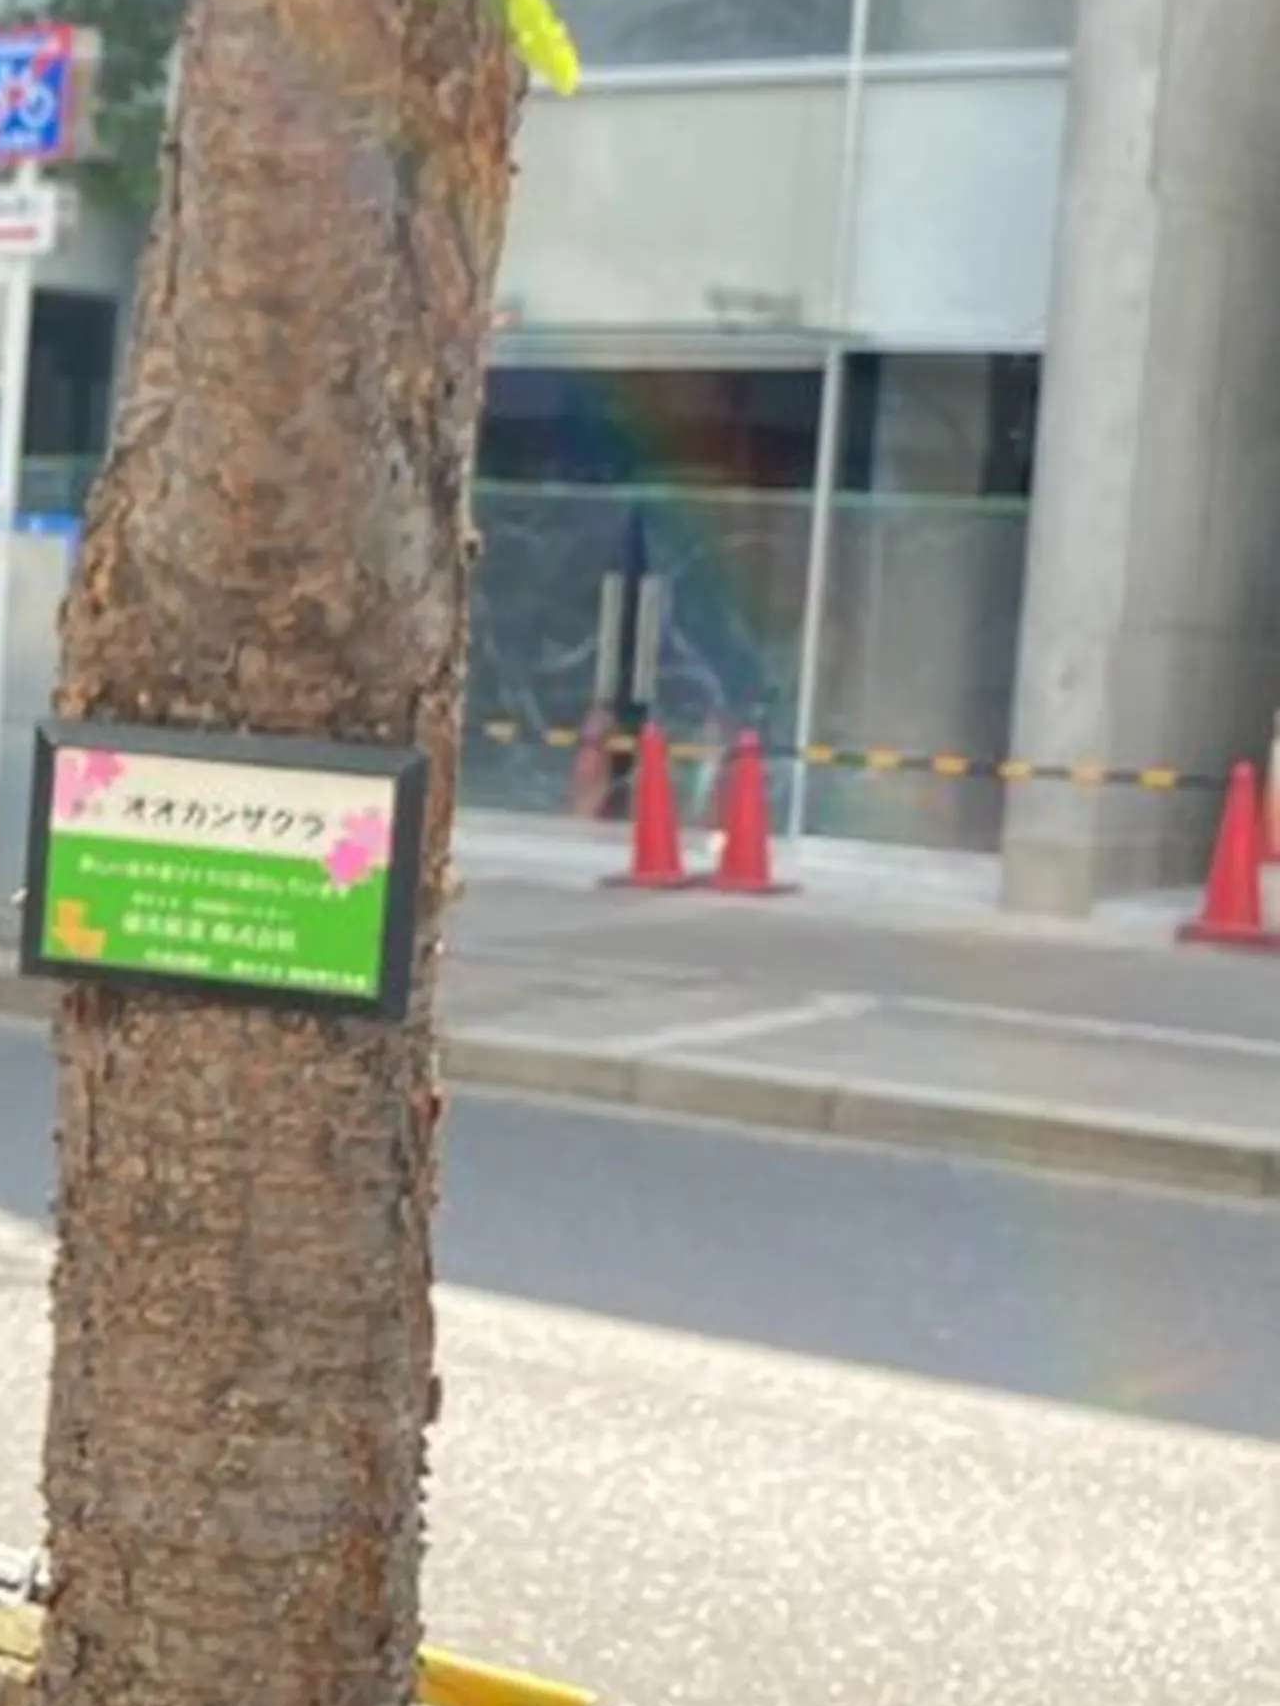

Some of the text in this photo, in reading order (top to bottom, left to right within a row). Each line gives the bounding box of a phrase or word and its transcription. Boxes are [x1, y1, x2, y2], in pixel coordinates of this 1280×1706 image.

[121, 796, 327, 841] オオカンザクラ
